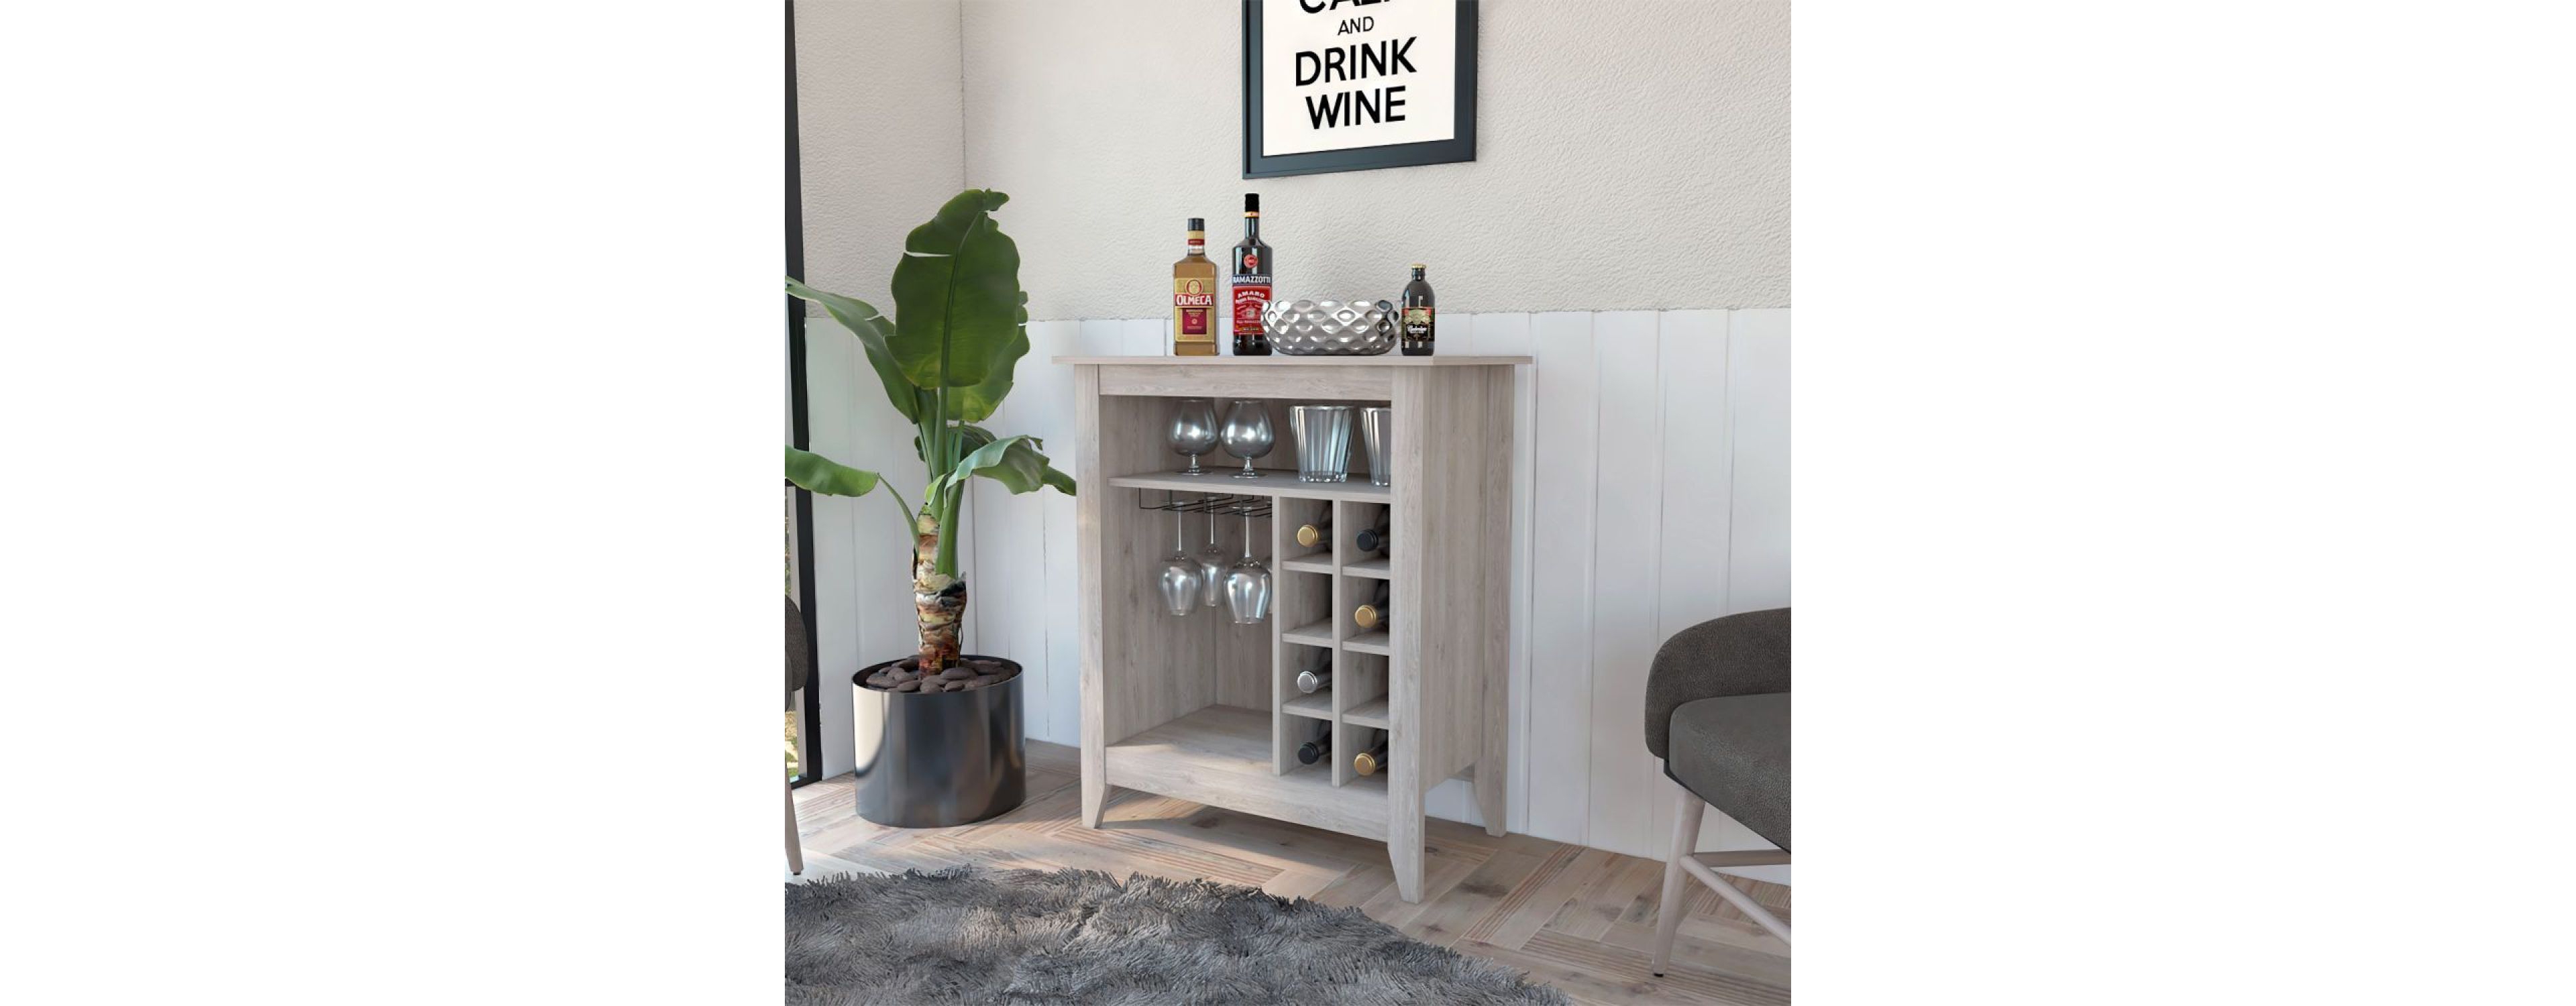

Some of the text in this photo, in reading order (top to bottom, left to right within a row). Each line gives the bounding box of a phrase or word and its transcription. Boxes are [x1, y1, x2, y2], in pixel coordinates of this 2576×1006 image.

[1338, 16, 1375, 36] AND
[1296, 36, 1417, 87] DRINK
[1305, 85, 1406, 129] WINE
[1177, 295, 1212, 305] OLMECA
[1237, 290, 1265, 298] AMARO
